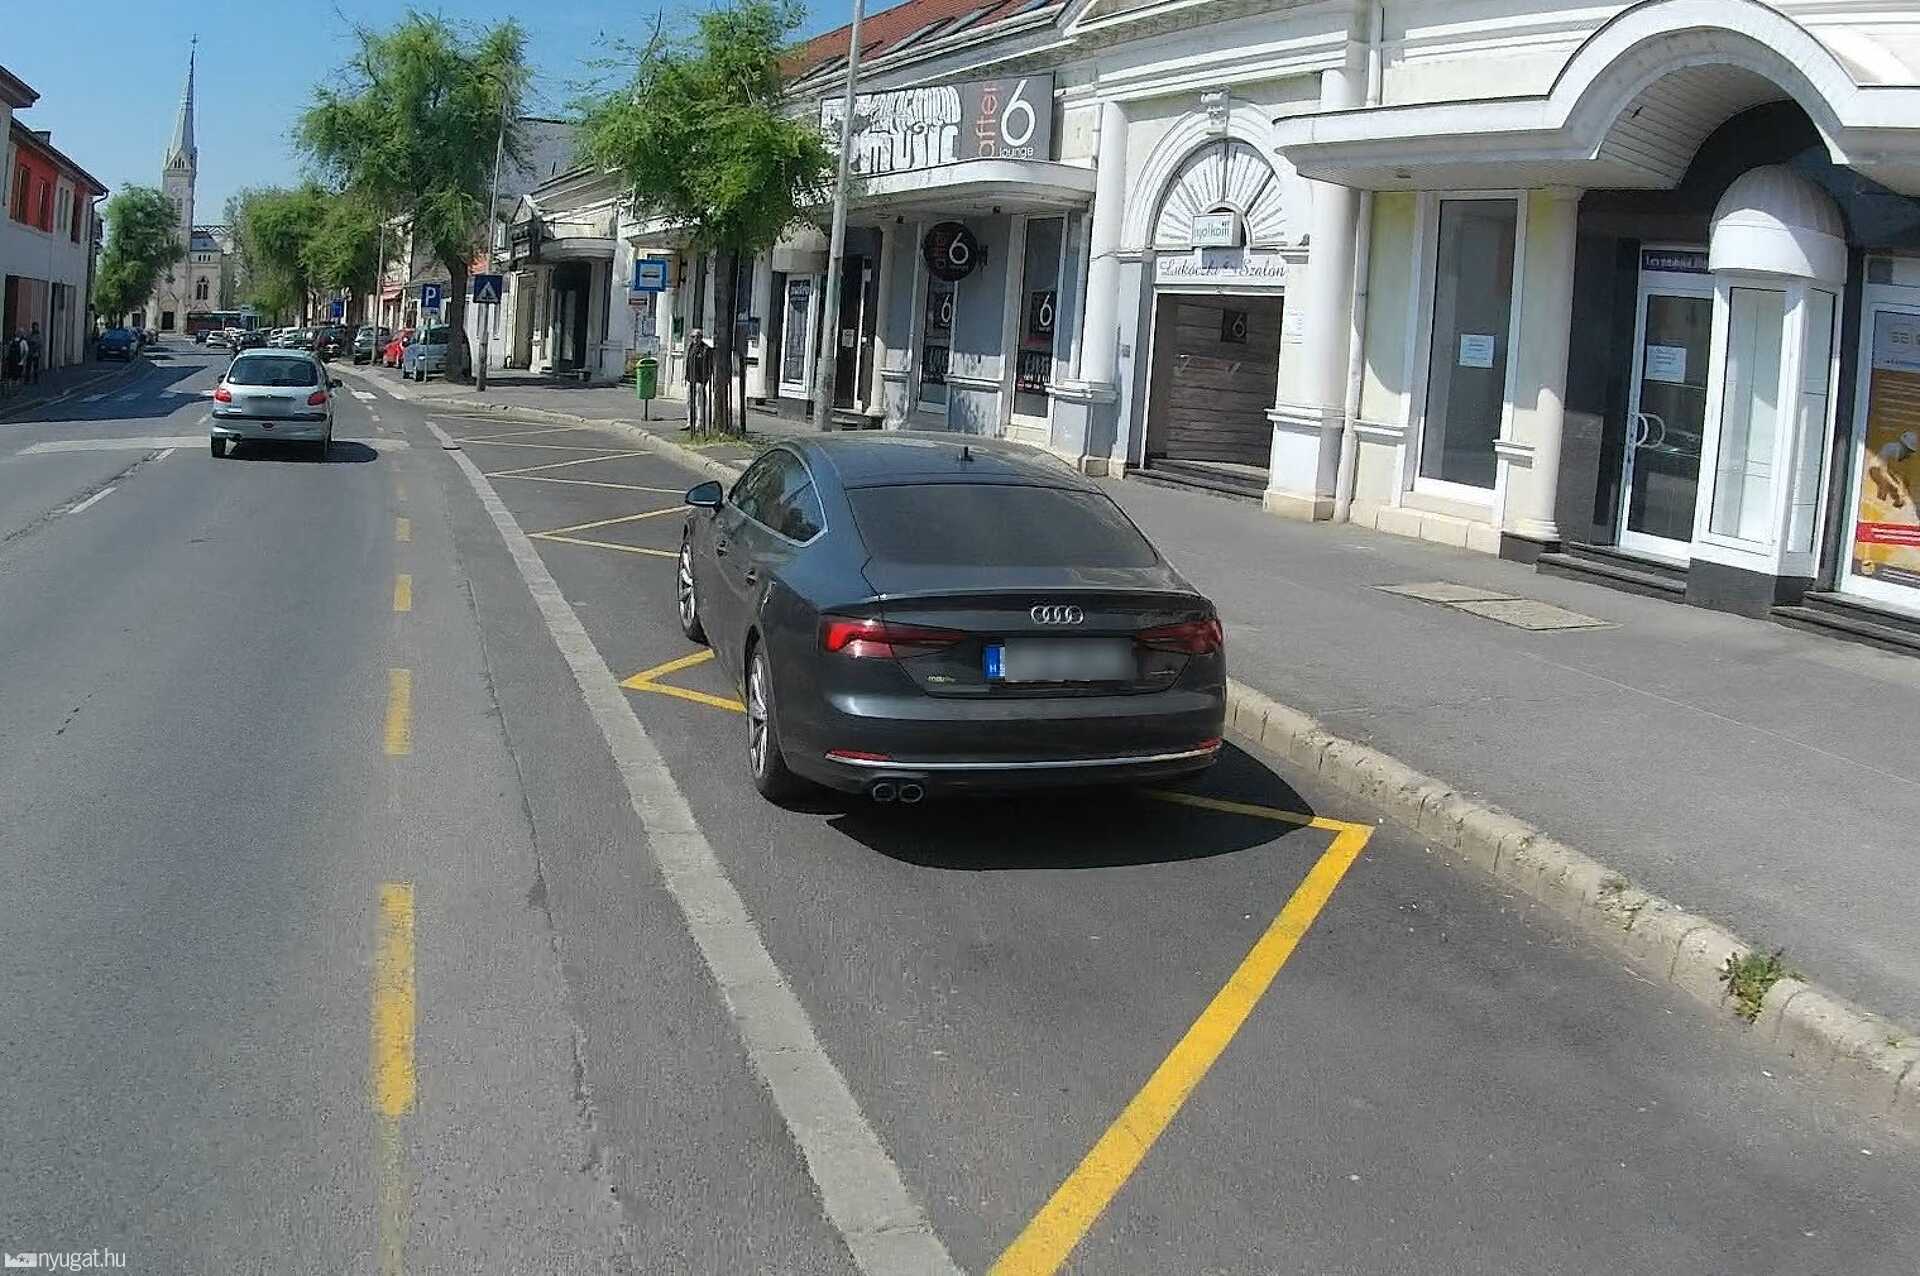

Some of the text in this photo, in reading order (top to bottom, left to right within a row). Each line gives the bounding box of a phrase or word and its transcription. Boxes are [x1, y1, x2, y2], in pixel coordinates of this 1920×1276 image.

[976, 81, 998, 157] after
[1001, 78, 1036, 147] 6
[1000, 147, 1034, 159] lounge
[949, 232, 969, 264] 6
[425, 287, 436, 305] P
[941, 294, 951, 323] 6
[1040, 294, 1052, 326] 6
[1232, 314, 1245, 337] 6
